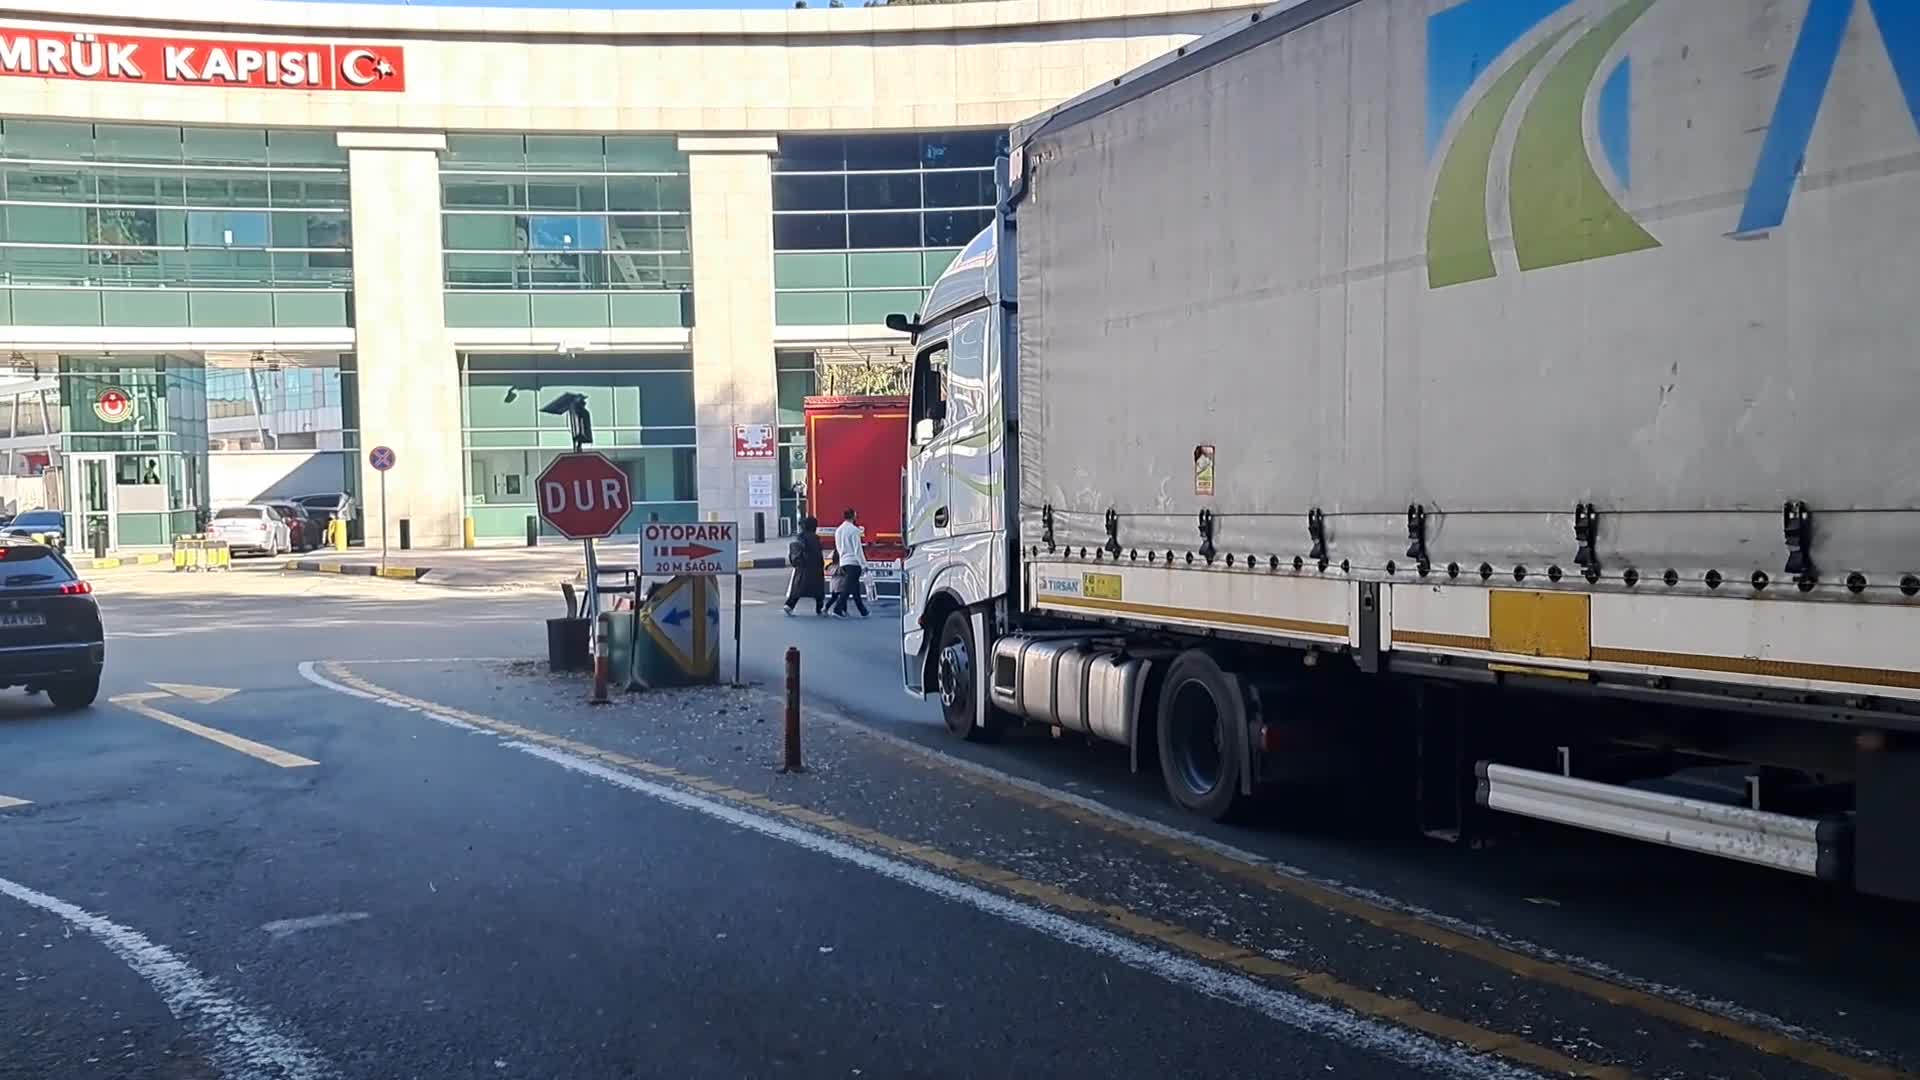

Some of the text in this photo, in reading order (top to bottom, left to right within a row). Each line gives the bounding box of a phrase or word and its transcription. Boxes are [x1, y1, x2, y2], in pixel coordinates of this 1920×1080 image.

[0, 34, 320, 85] MRÜK KAPISI
[545, 478, 622, 513] DUR
[646, 525, 732, 541] OTOPARK
[656, 559, 722, 572] 20 M SAĞDA
[1048, 580, 1079, 593] TIRSAN
